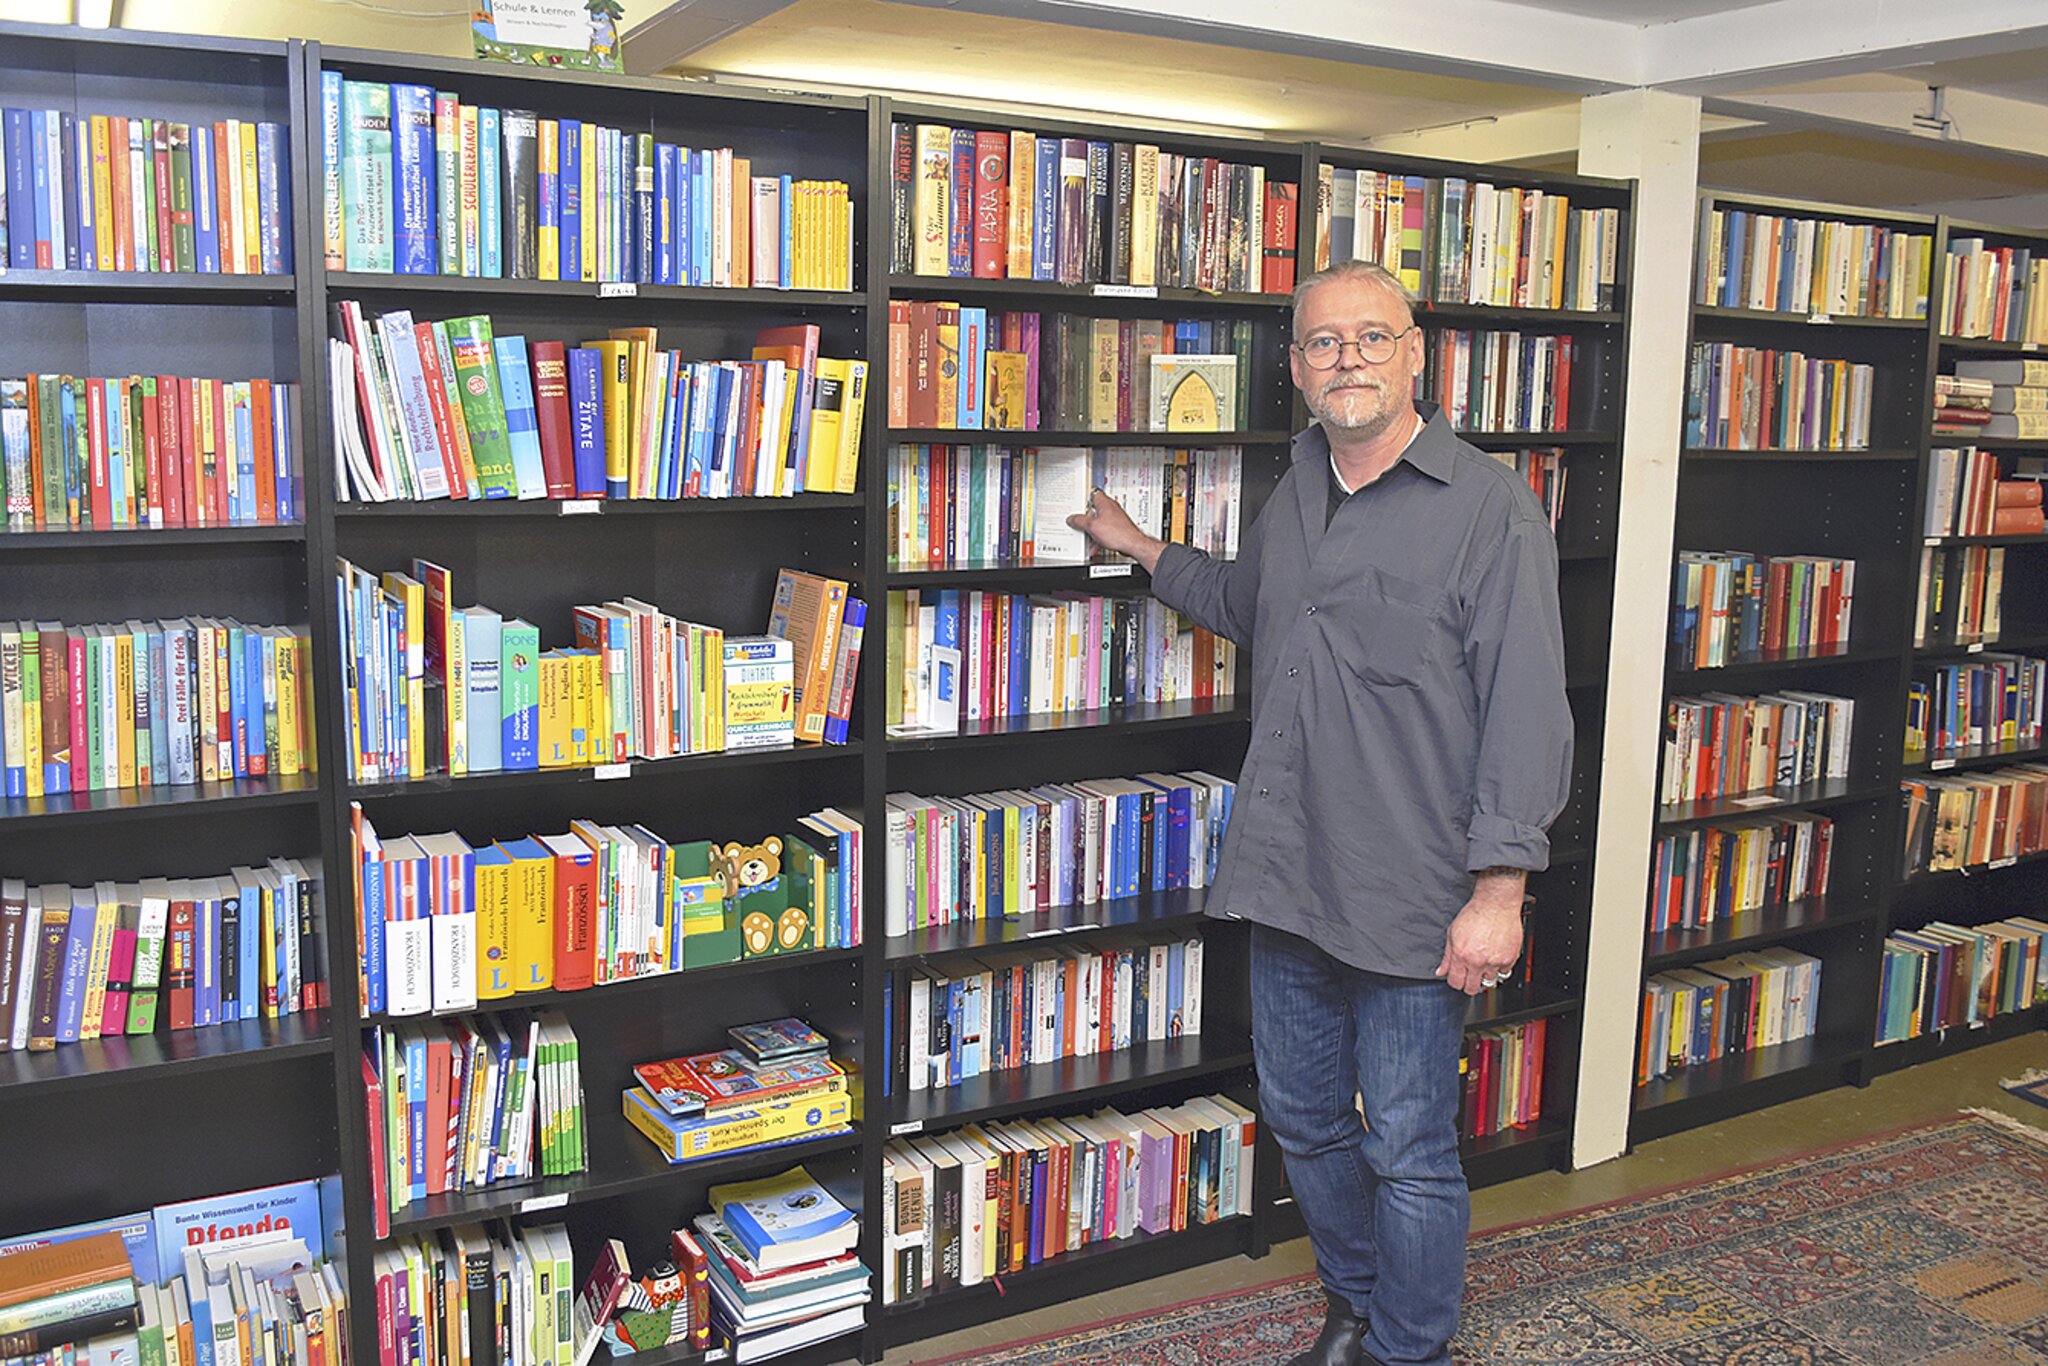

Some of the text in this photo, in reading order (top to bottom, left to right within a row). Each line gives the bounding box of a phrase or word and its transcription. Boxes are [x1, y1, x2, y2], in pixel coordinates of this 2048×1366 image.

[493, 1, 576, 18] Schule & Lernen
[459, 119, 477, 211] SCHÜLERLEXIKON
[364, 138, 376, 245] Kreuzworträtsel Lexikon
[588, 368, 597, 403] Lexikon
[404, 401, 423, 454] Neue deutsche
[410, 374, 436, 451] Rechtschreibung
[579, 401, 592, 449] ZITATE
[504, 635, 536, 646] PONS
[811, 604, 838, 712] Englisch für FORTGESCHRITTENE
[3, 643, 18, 693] WICKIE
[174, 636, 187, 723] Drei Fälle für Erich
[452, 623, 463, 721] MEYERS KINDER LEXIKON
[561, 662, 570, 700] Englisch
[577, 662, 586, 700] Englisch
[991, 832, 1000, 896] Julie PARSONS
[370, 866, 380, 926] FRANZÖSISCHE
[499, 867, 509, 961] Französisch-Deutsch
[537, 865, 547, 924] Französisch
[573, 882, 589, 952] Französisch
[65, 937, 81, 997] Hals über Kopf
[77, 947, 89, 977] verliebt
[136, 953, 148, 985] RUBY
[404, 930, 416, 996] FRANZÖSISCH
[450, 924, 462, 989] FRANZÖSISCH
[771, 1115, 786, 1125] Der
[175, 1195, 298, 1225] Bunte Wissenswelt für Kinder
[899, 1190, 910, 1226] BONITA
[910, 1186, 922, 1224] AVENUE
[943, 1246, 952, 1274] NORA
[951, 1236, 960, 1279] ROBERTS
